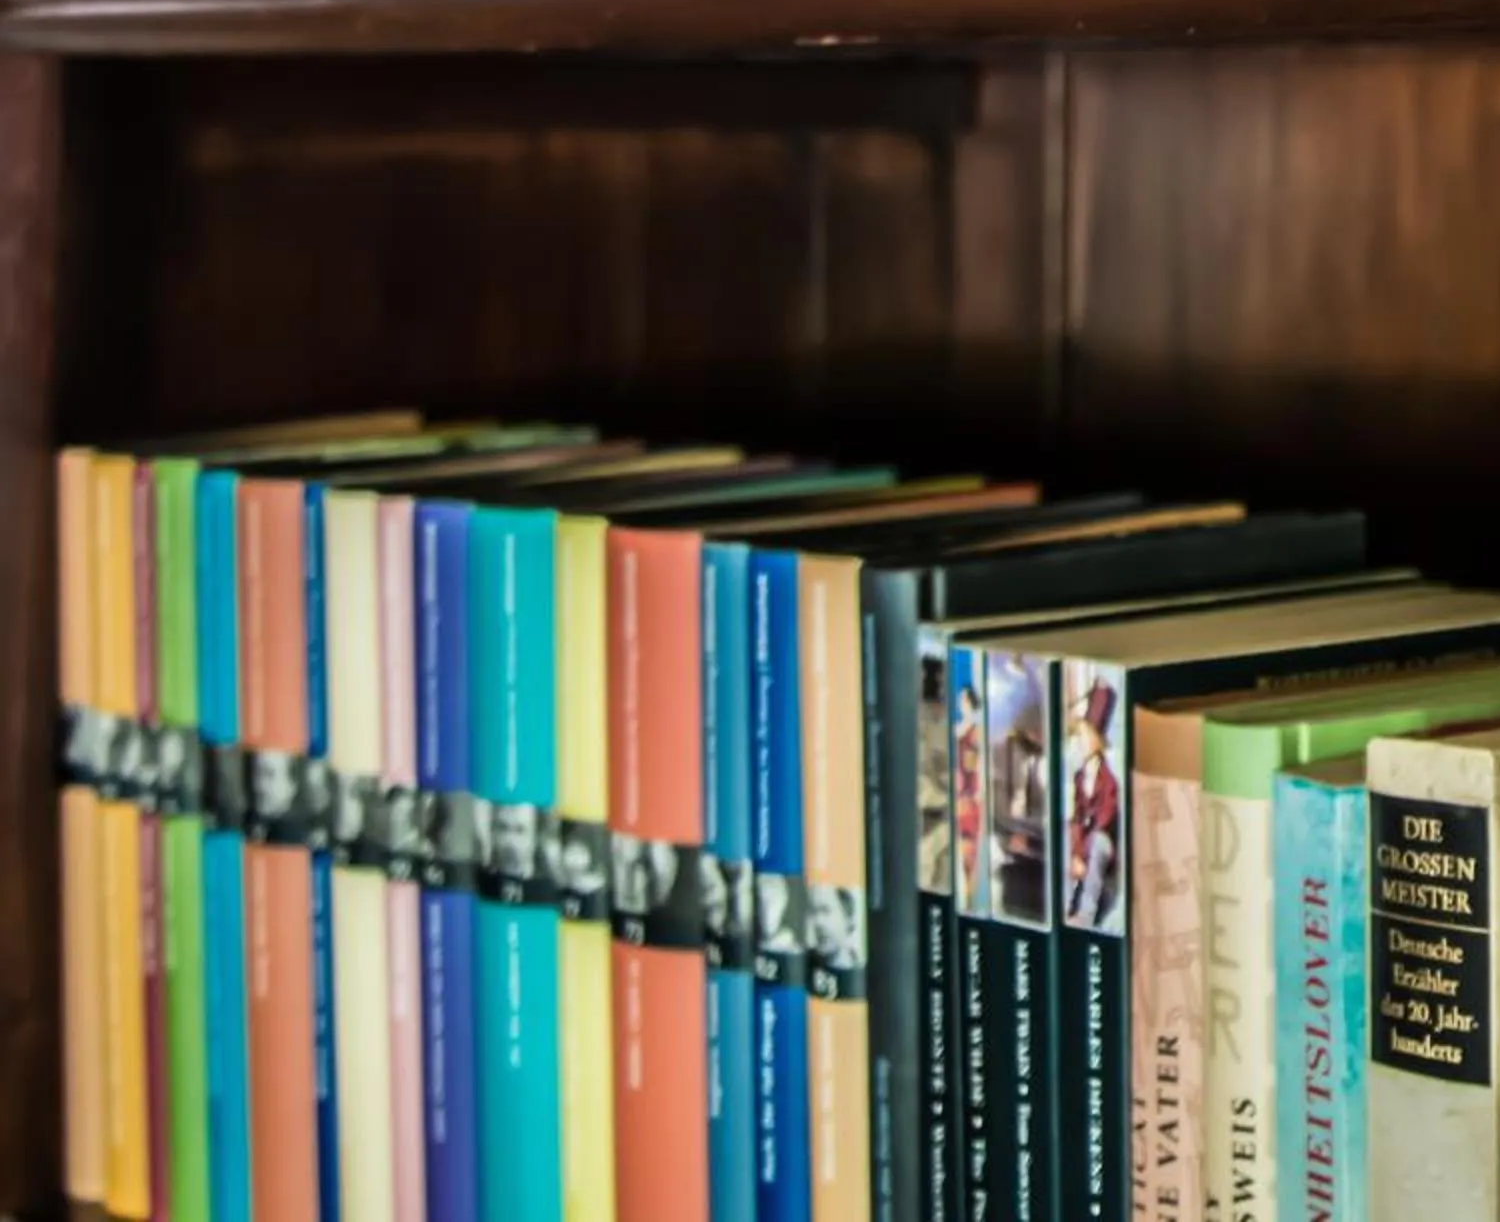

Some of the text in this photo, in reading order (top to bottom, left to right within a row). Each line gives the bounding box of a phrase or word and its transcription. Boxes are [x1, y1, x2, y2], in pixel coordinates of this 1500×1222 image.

[1402, 814, 1443, 843] DIE
[1377, 844, 1477, 882] GROSSEN
[1381, 879, 1472, 915] MEISTER
[1389, 928, 1464, 964] Deutsche
[1393, 962, 1460, 996] Erzähler
[1088, 944, 1102, 1070] CHARLES
[1407, 1000, 1433, 1025] 20.
[1435, 1003, 1479, 1033] Jahr-
[1391, 1028, 1463, 1065] hunderts
[1155, 1034, 1181, 1168] VATER
